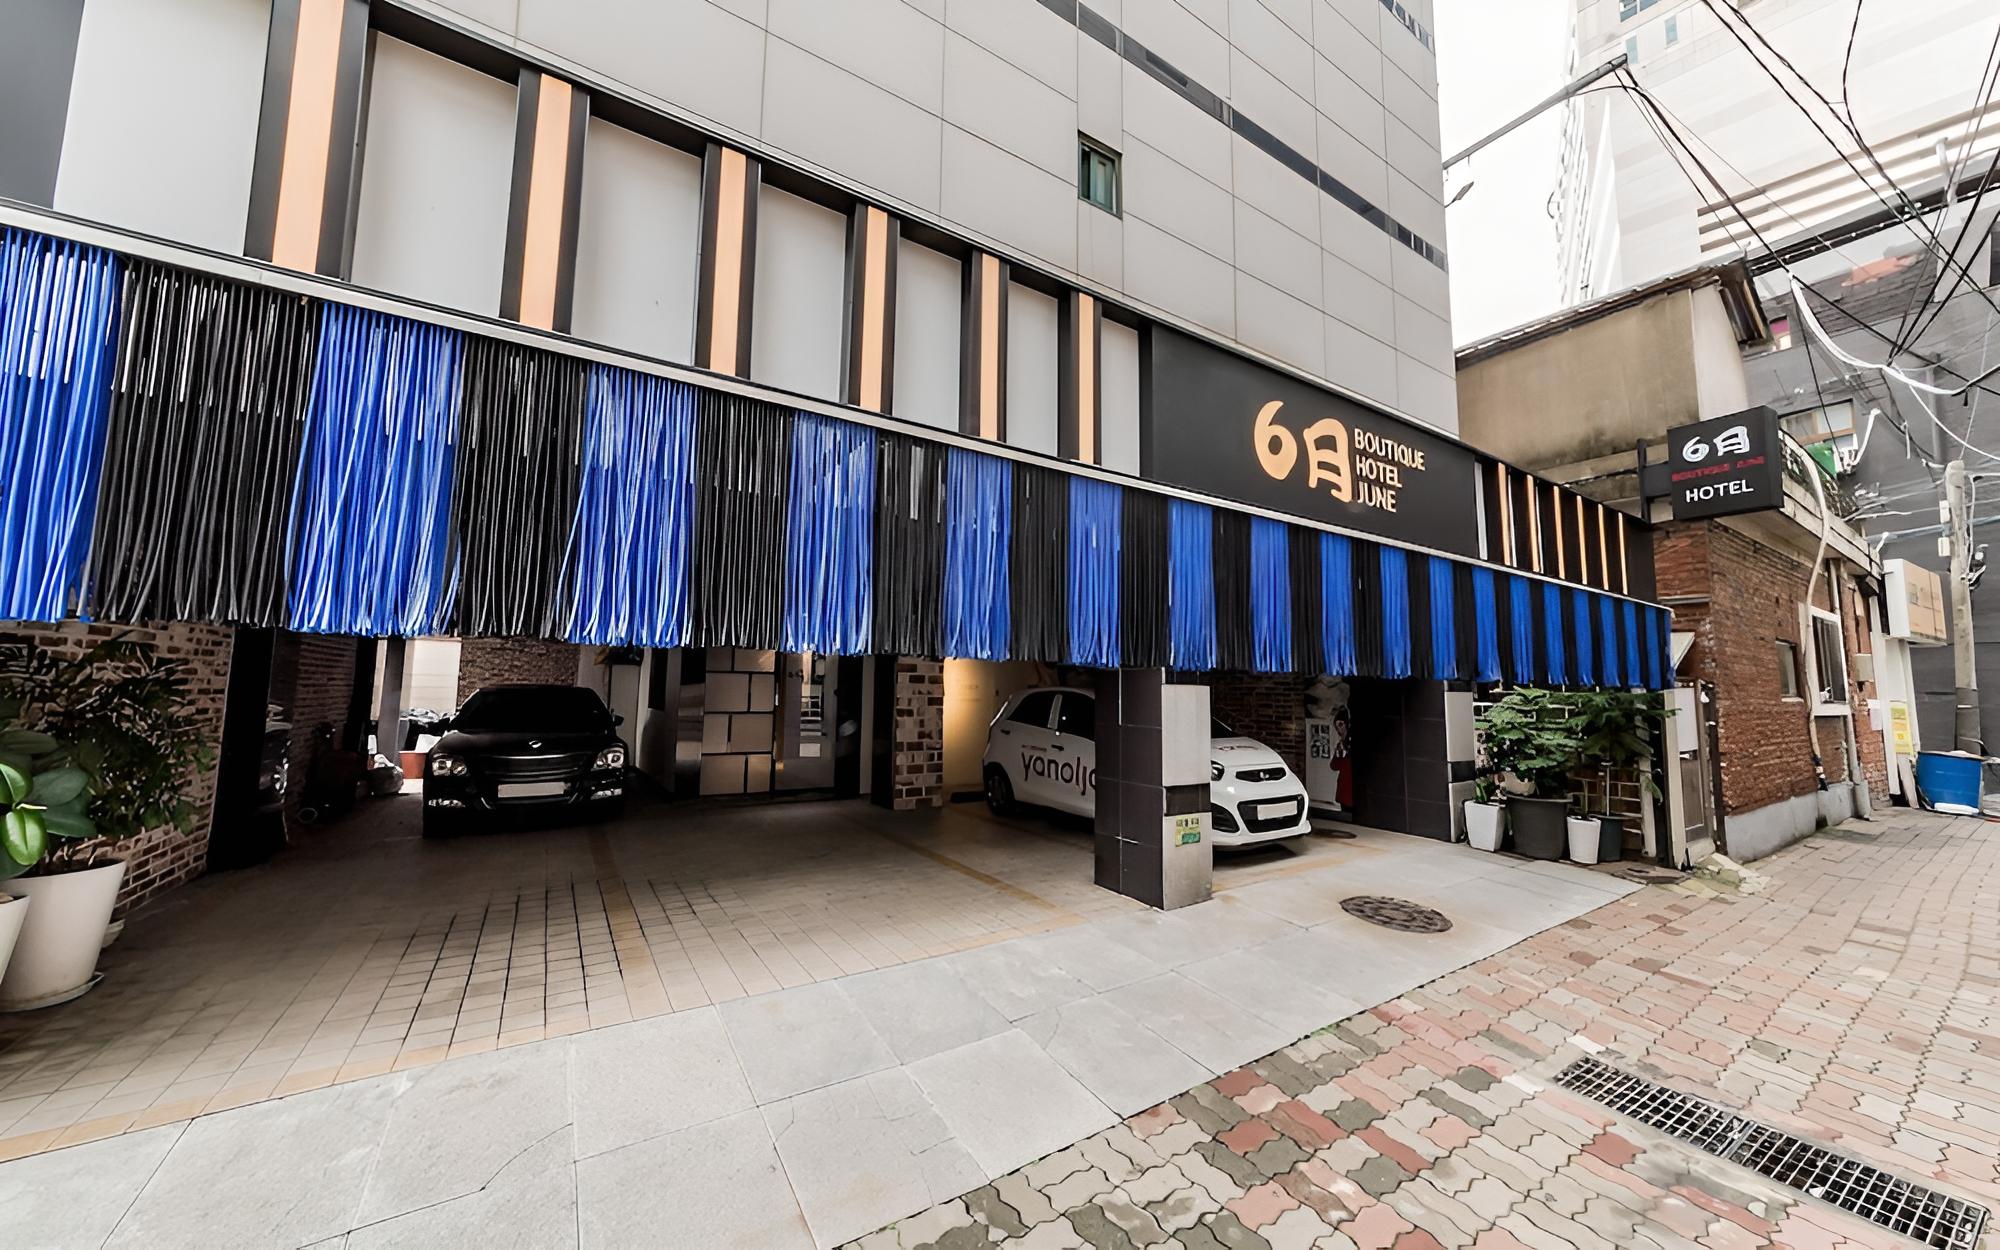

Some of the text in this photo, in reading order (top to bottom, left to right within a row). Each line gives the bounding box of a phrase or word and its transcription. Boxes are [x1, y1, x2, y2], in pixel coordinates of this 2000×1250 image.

[1354, 428, 1426, 471] BOUTIQUE
[1356, 454, 1402, 488] HOTEL
[1357, 482, 1397, 513] JUNE
[1686, 479, 1754, 503] HOTEL
